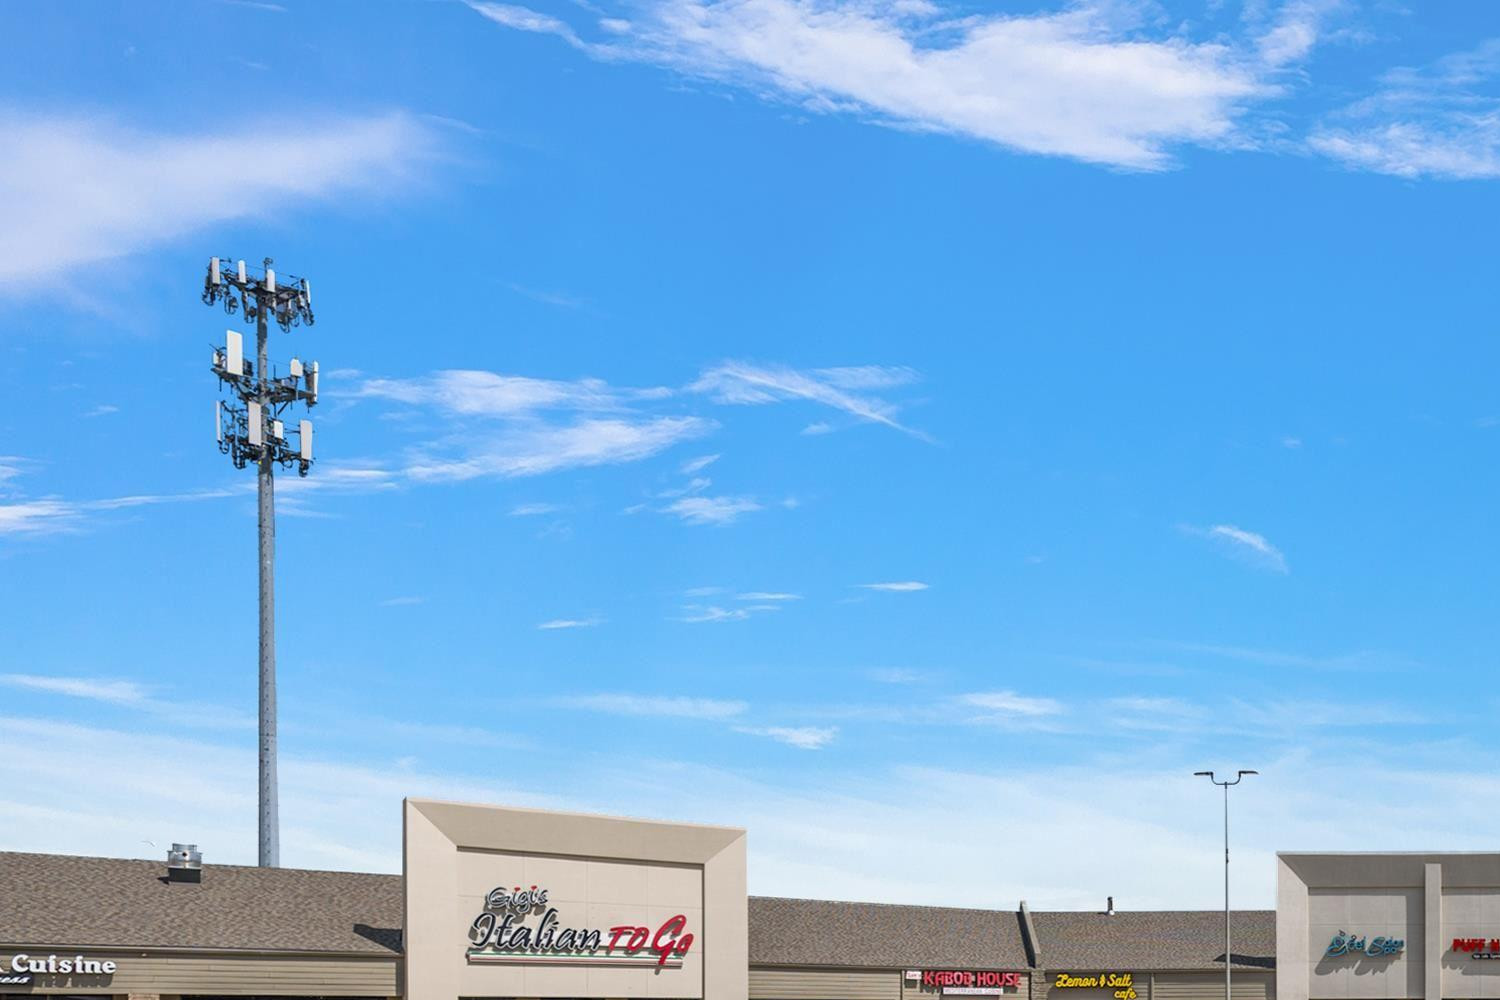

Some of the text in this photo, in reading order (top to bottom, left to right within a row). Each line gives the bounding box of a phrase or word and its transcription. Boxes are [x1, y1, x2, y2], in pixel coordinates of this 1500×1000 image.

[472, 907, 602, 951] Italian
[651, 914, 695, 966] Go
[1452, 938, 1486, 952] PUFF
[11, 954, 117, 974] Cuisine
[923, 970, 973, 986] KABOB
[976, 971, 1022, 987] HOUSE
[1055, 973, 1098, 987] Lemon
[1107, 973, 1132, 987] Salt
